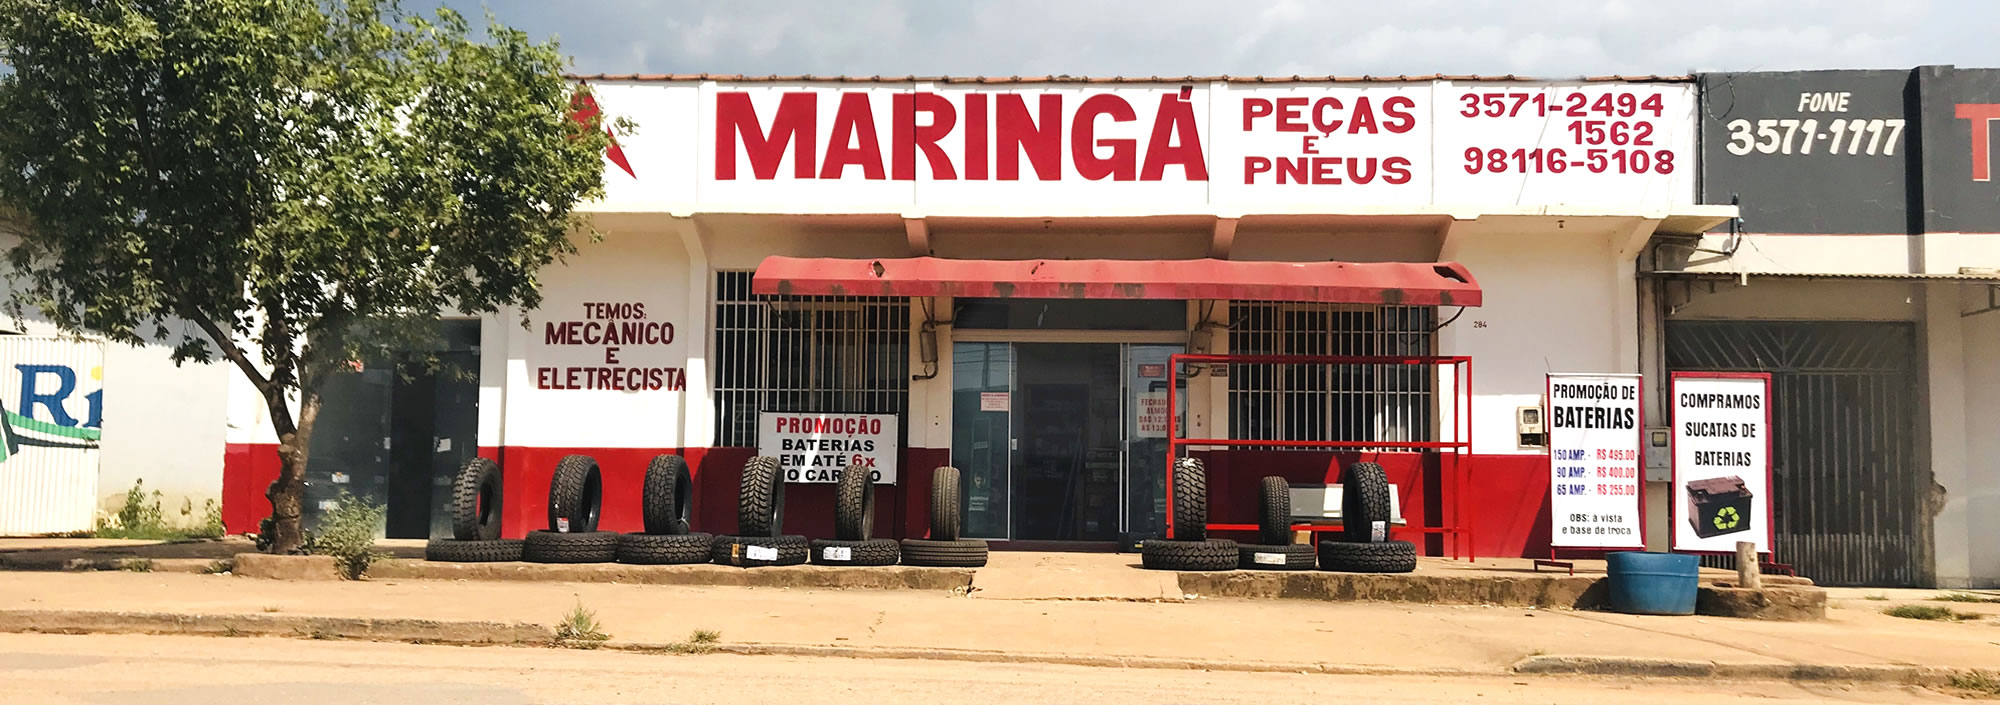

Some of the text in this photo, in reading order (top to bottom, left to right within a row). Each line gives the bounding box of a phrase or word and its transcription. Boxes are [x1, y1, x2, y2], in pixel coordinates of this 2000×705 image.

[1460, 92, 1664, 118] 3571-2494
[1798, 92, 1850, 113] FONE
[1243, 96, 1415, 138] PEÇAS
[715, 85, 1208, 181] MARINGÁ
[1568, 120, 1653, 146] 1562
[1726, 118, 1905, 156] 3571-1117
[1303, 135, 1319, 154] E
[1244, 156, 1412, 185] PNEUS
[1464, 147, 1675, 175] 98116-5108
[583, 302, 647, 320] TEMOS:
[545, 319, 674, 345] MECÂNICO
[606, 347, 620, 364] E
[537, 367, 687, 391] ELETRECISTA
[1553, 382, 1635, 403] PROMOÇÃO DE
[1680, 393, 1760, 409] COMPRAMOS
[776, 415, 881, 438] PROMOÇÃO
[1554, 406, 1634, 430] BATERIAS
[1685, 421, 1756, 438] SUCATAS DE
[782, 439, 874, 452] BATERIAS
[1553, 449, 1566, 461] 150
[1609, 449, 1635, 461] 495.00
[780, 454, 805, 466] EM
[811, 452, 846, 467] ATÉ
[1695, 450, 1751, 466] BATERIAS
[1557, 467, 1566, 478] 90
[1609, 467, 1635, 478] 400.00
[1557, 484, 1566, 495] 65
[1609, 484, 1635, 495] 255.00
[1600, 514, 1623, 522] vista
[1570, 526, 1591, 534] base
[1595, 526, 1605, 535] de
[1608, 526, 1631, 535] troca
